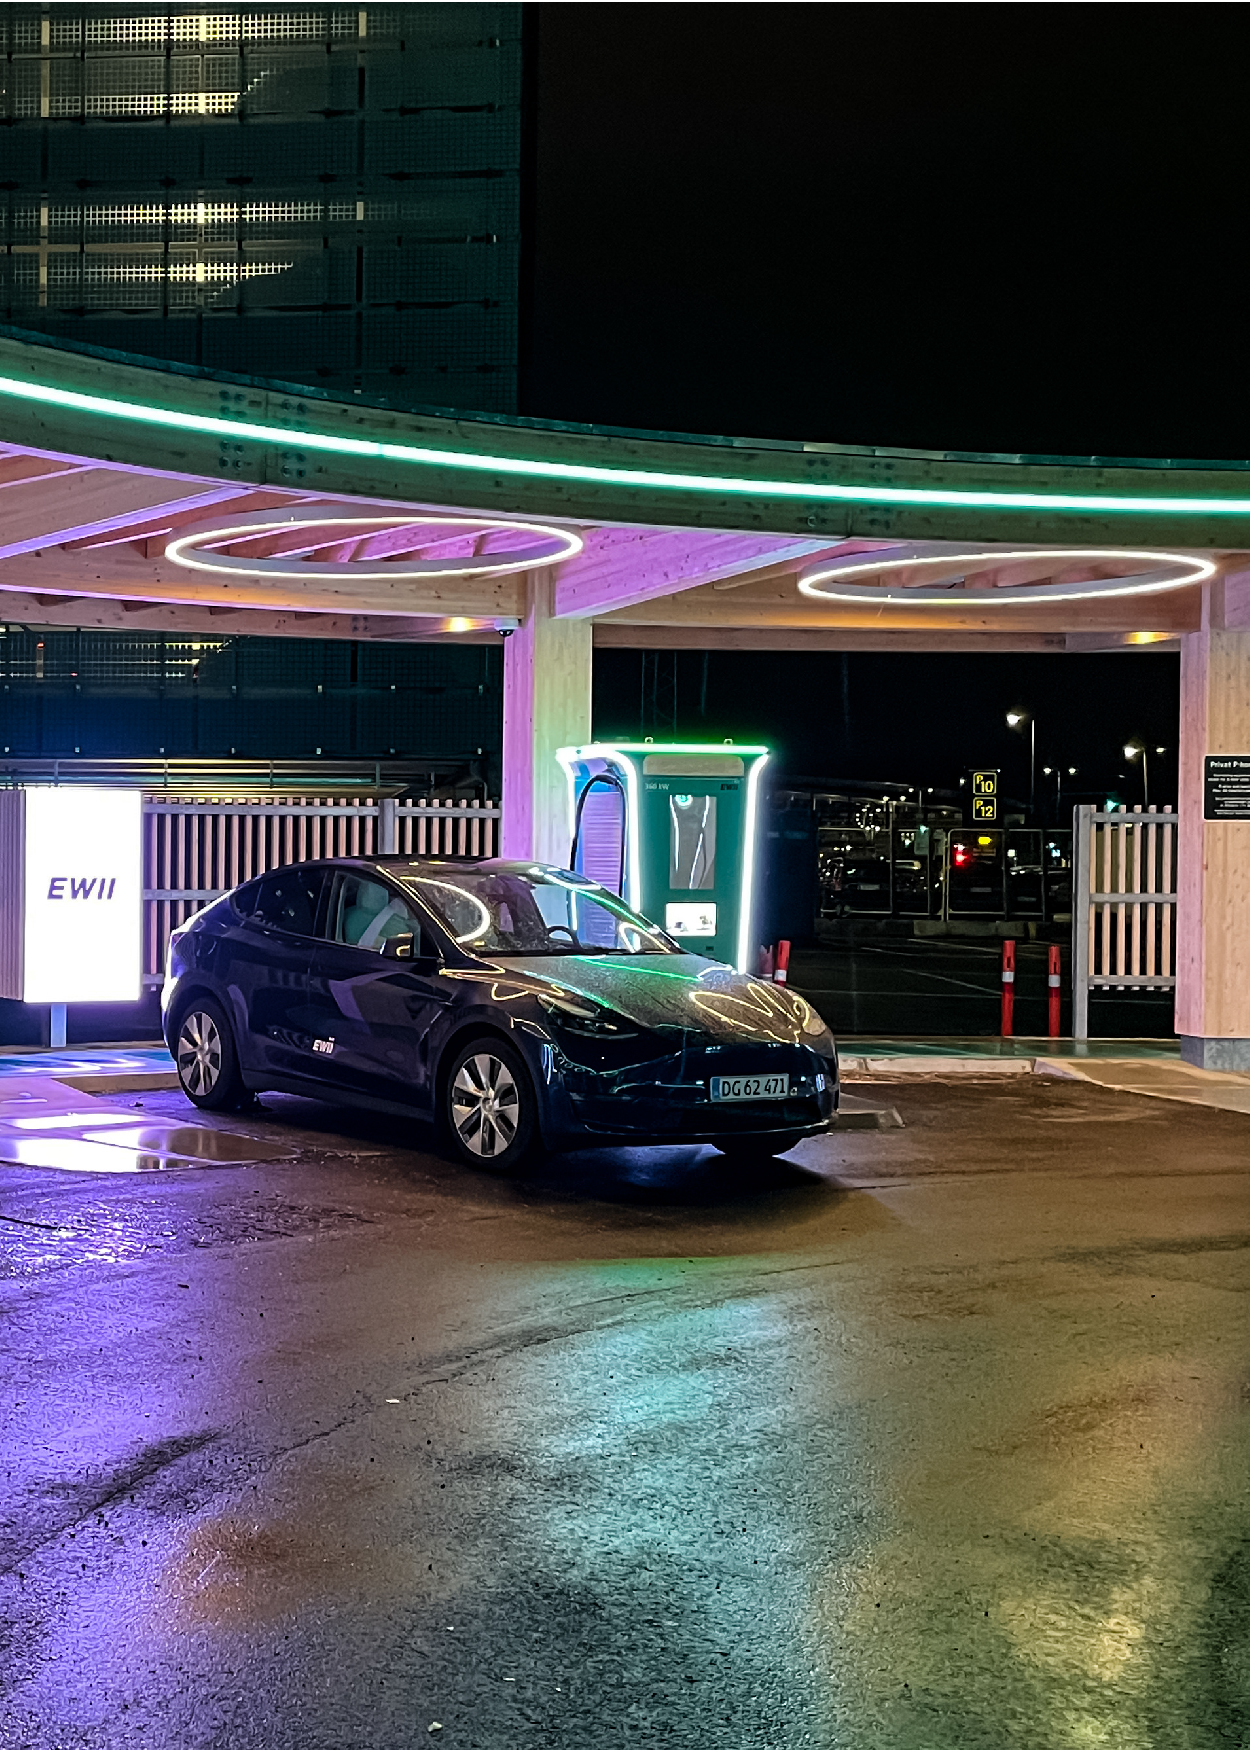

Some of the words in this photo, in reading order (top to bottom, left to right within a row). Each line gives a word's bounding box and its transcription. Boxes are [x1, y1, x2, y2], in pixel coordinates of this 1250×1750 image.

[1210, 760, 1232, 768] Privat
[47, 877, 116, 900] EWII
[722, 1080, 741, 1097] DG
[744, 1079, 761, 1096] 62
[764, 1077, 786, 1094] 471
